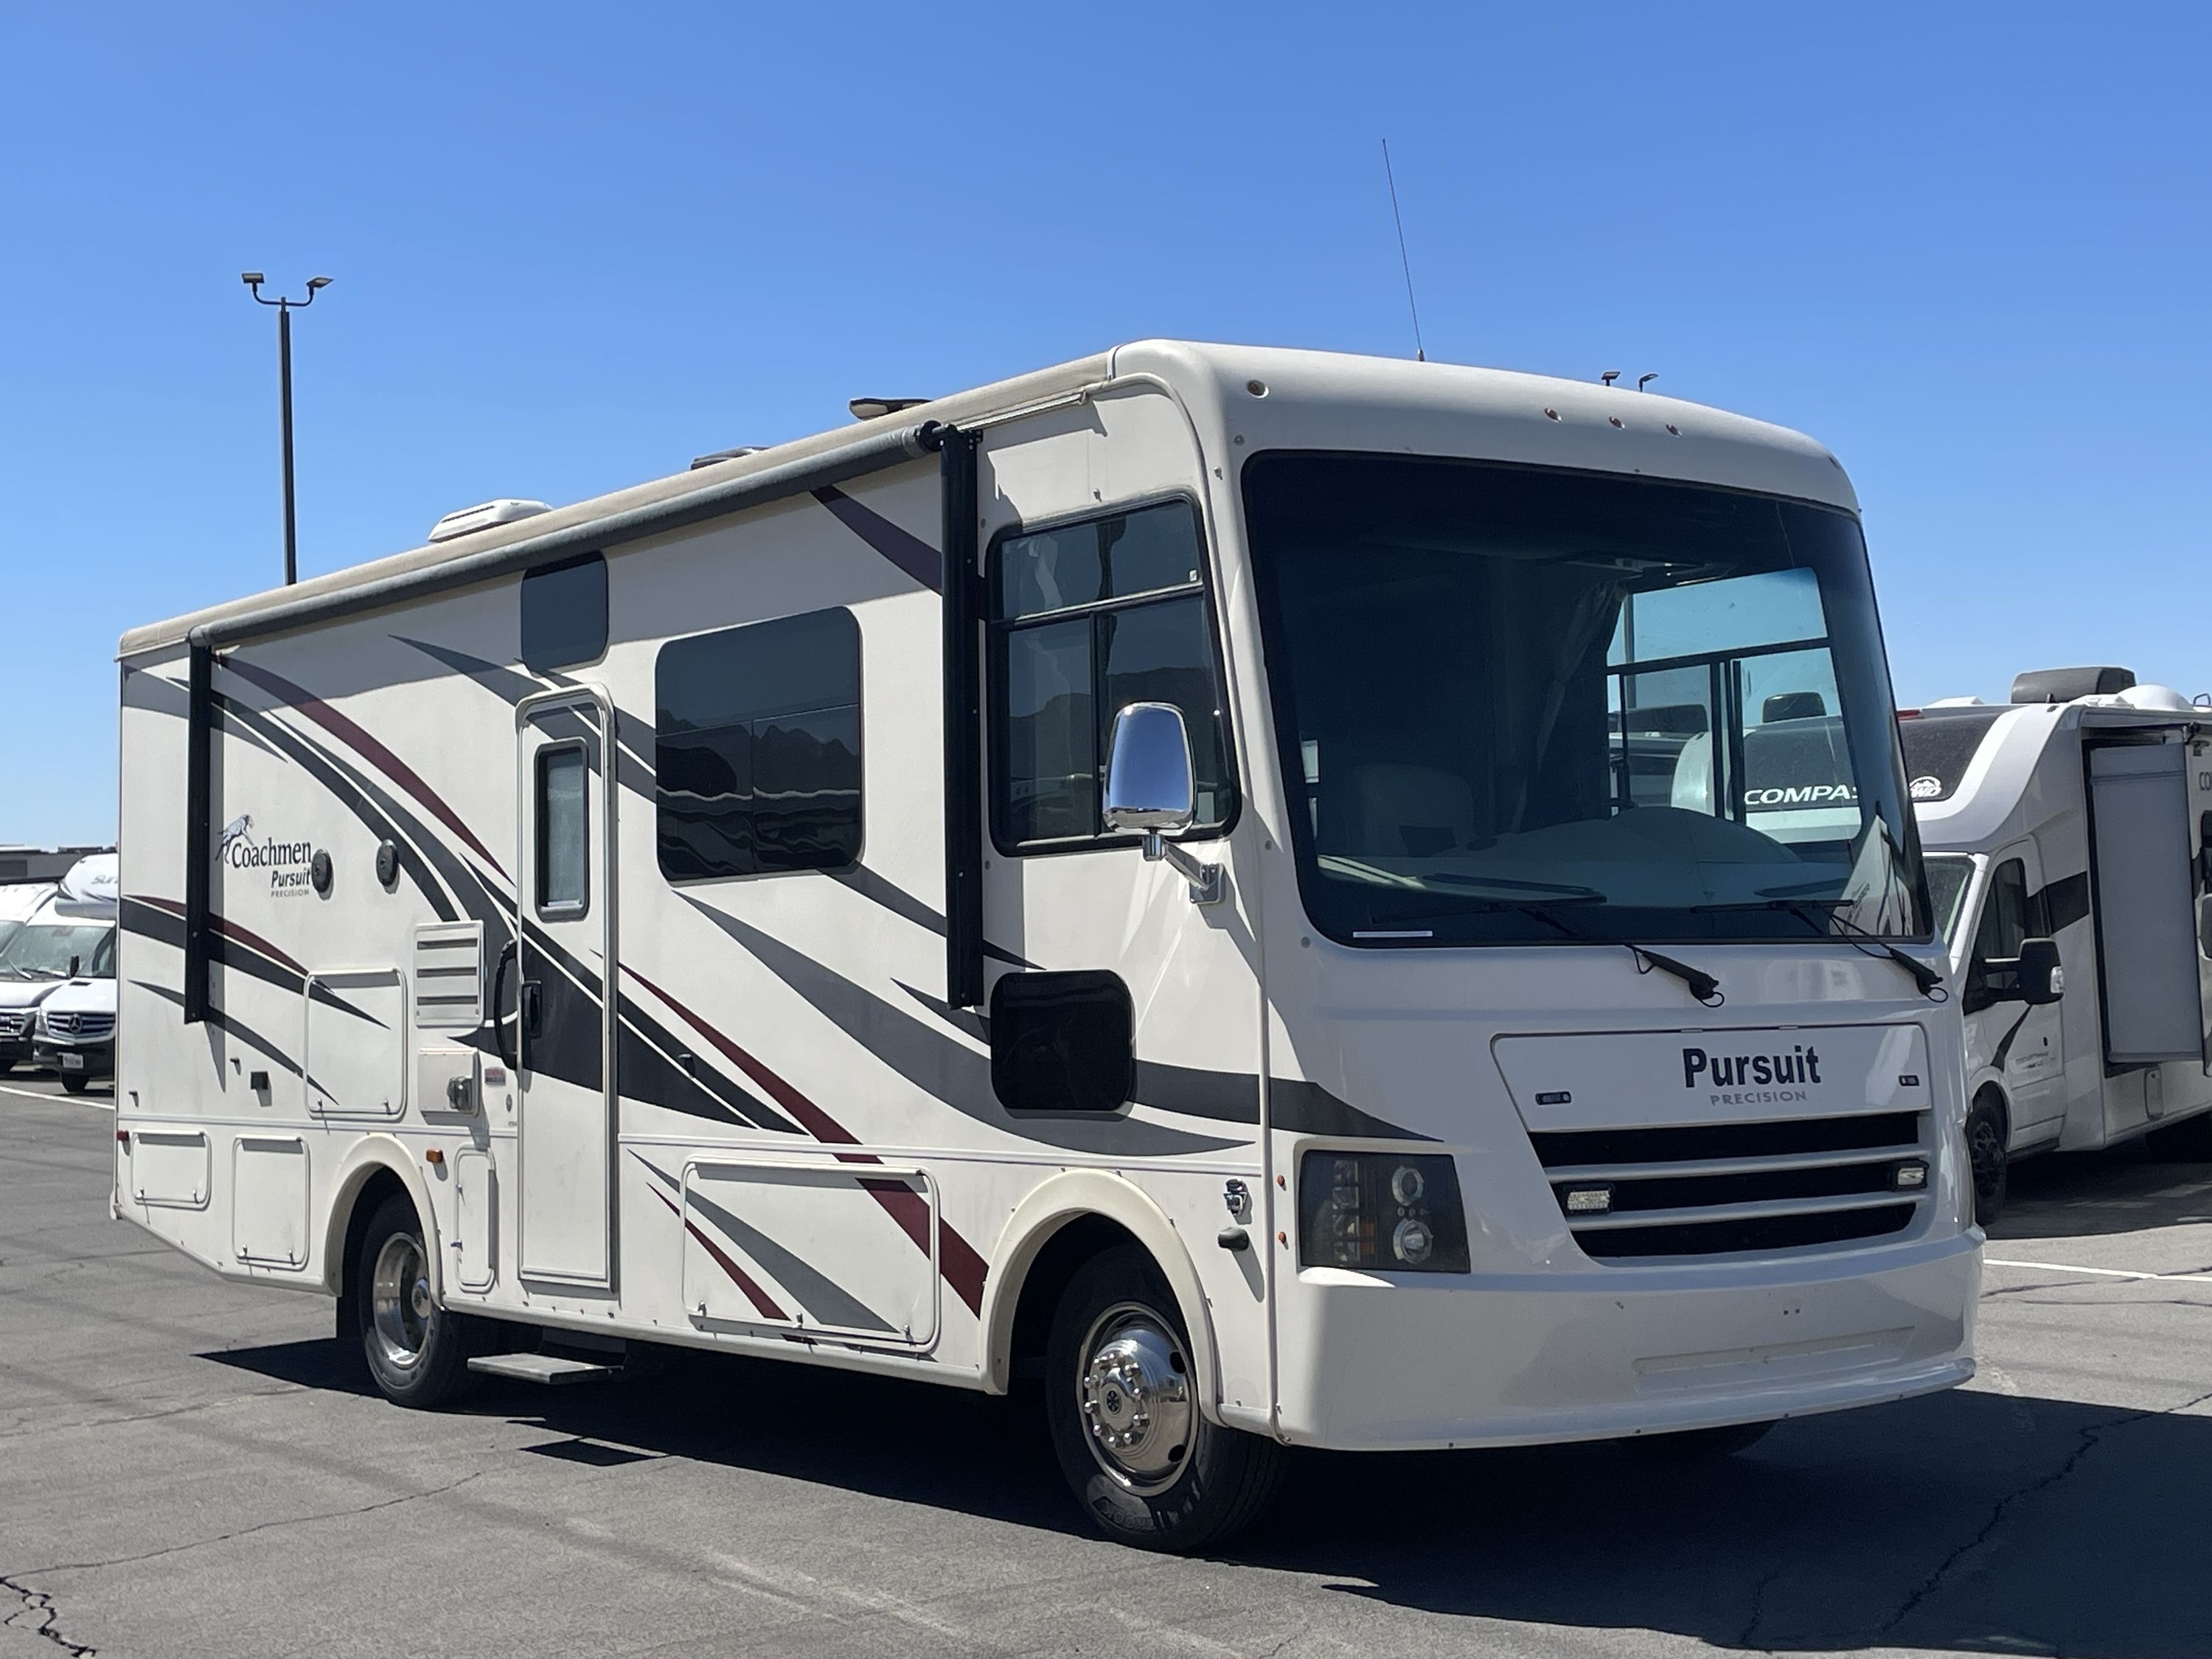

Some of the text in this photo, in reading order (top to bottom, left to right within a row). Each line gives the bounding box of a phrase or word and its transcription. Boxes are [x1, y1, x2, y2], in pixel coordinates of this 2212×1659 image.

[1744, 784, 1858, 805] COMPA
[232, 836, 312, 869] Coachmen
[271, 868, 311, 888] Pursuit
[271, 888, 310, 897] PRECISION
[1682, 1045, 1821, 1088] Pursuit
[1709, 1091, 1807, 1107] PRECISION
